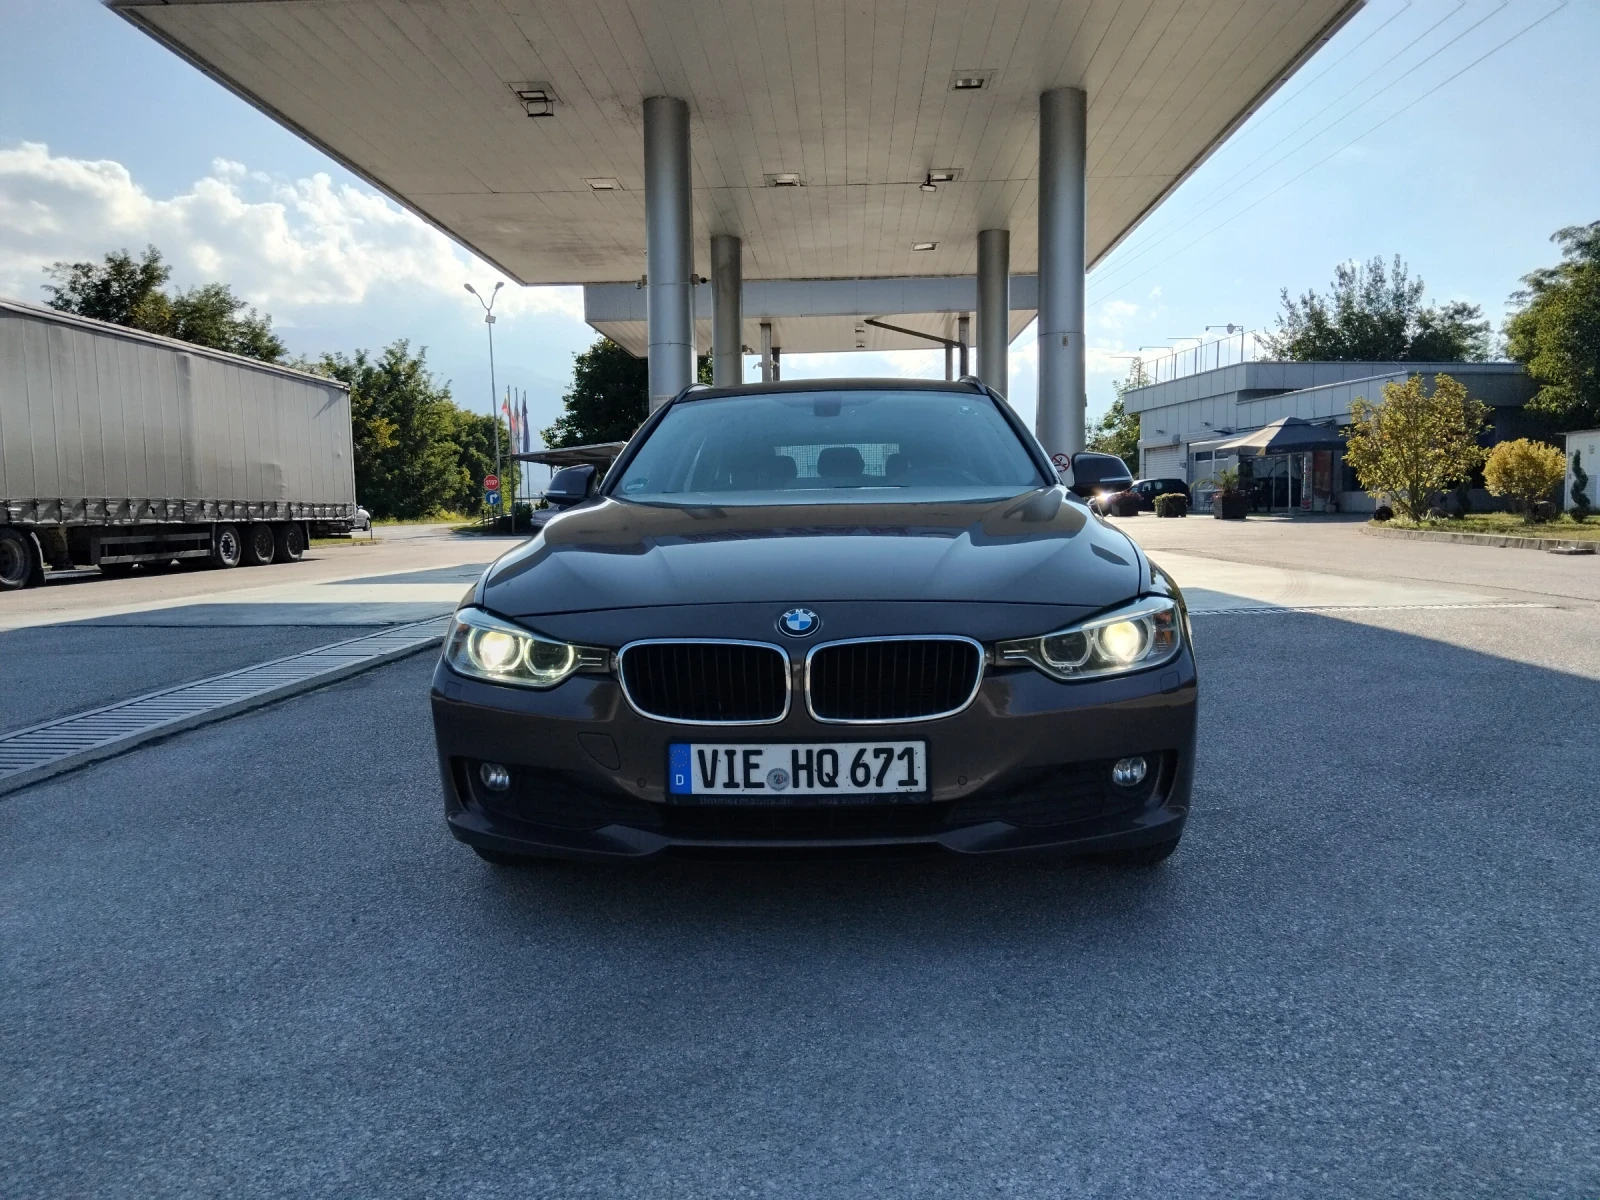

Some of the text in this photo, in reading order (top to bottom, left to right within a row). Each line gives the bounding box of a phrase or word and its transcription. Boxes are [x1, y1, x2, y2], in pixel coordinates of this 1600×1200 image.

[783, 609, 816, 617] BMW
[698, 749, 765, 788] VIE
[792, 749, 839, 788] HQ
[850, 747, 918, 786] 671
[675, 774, 685, 786] D
